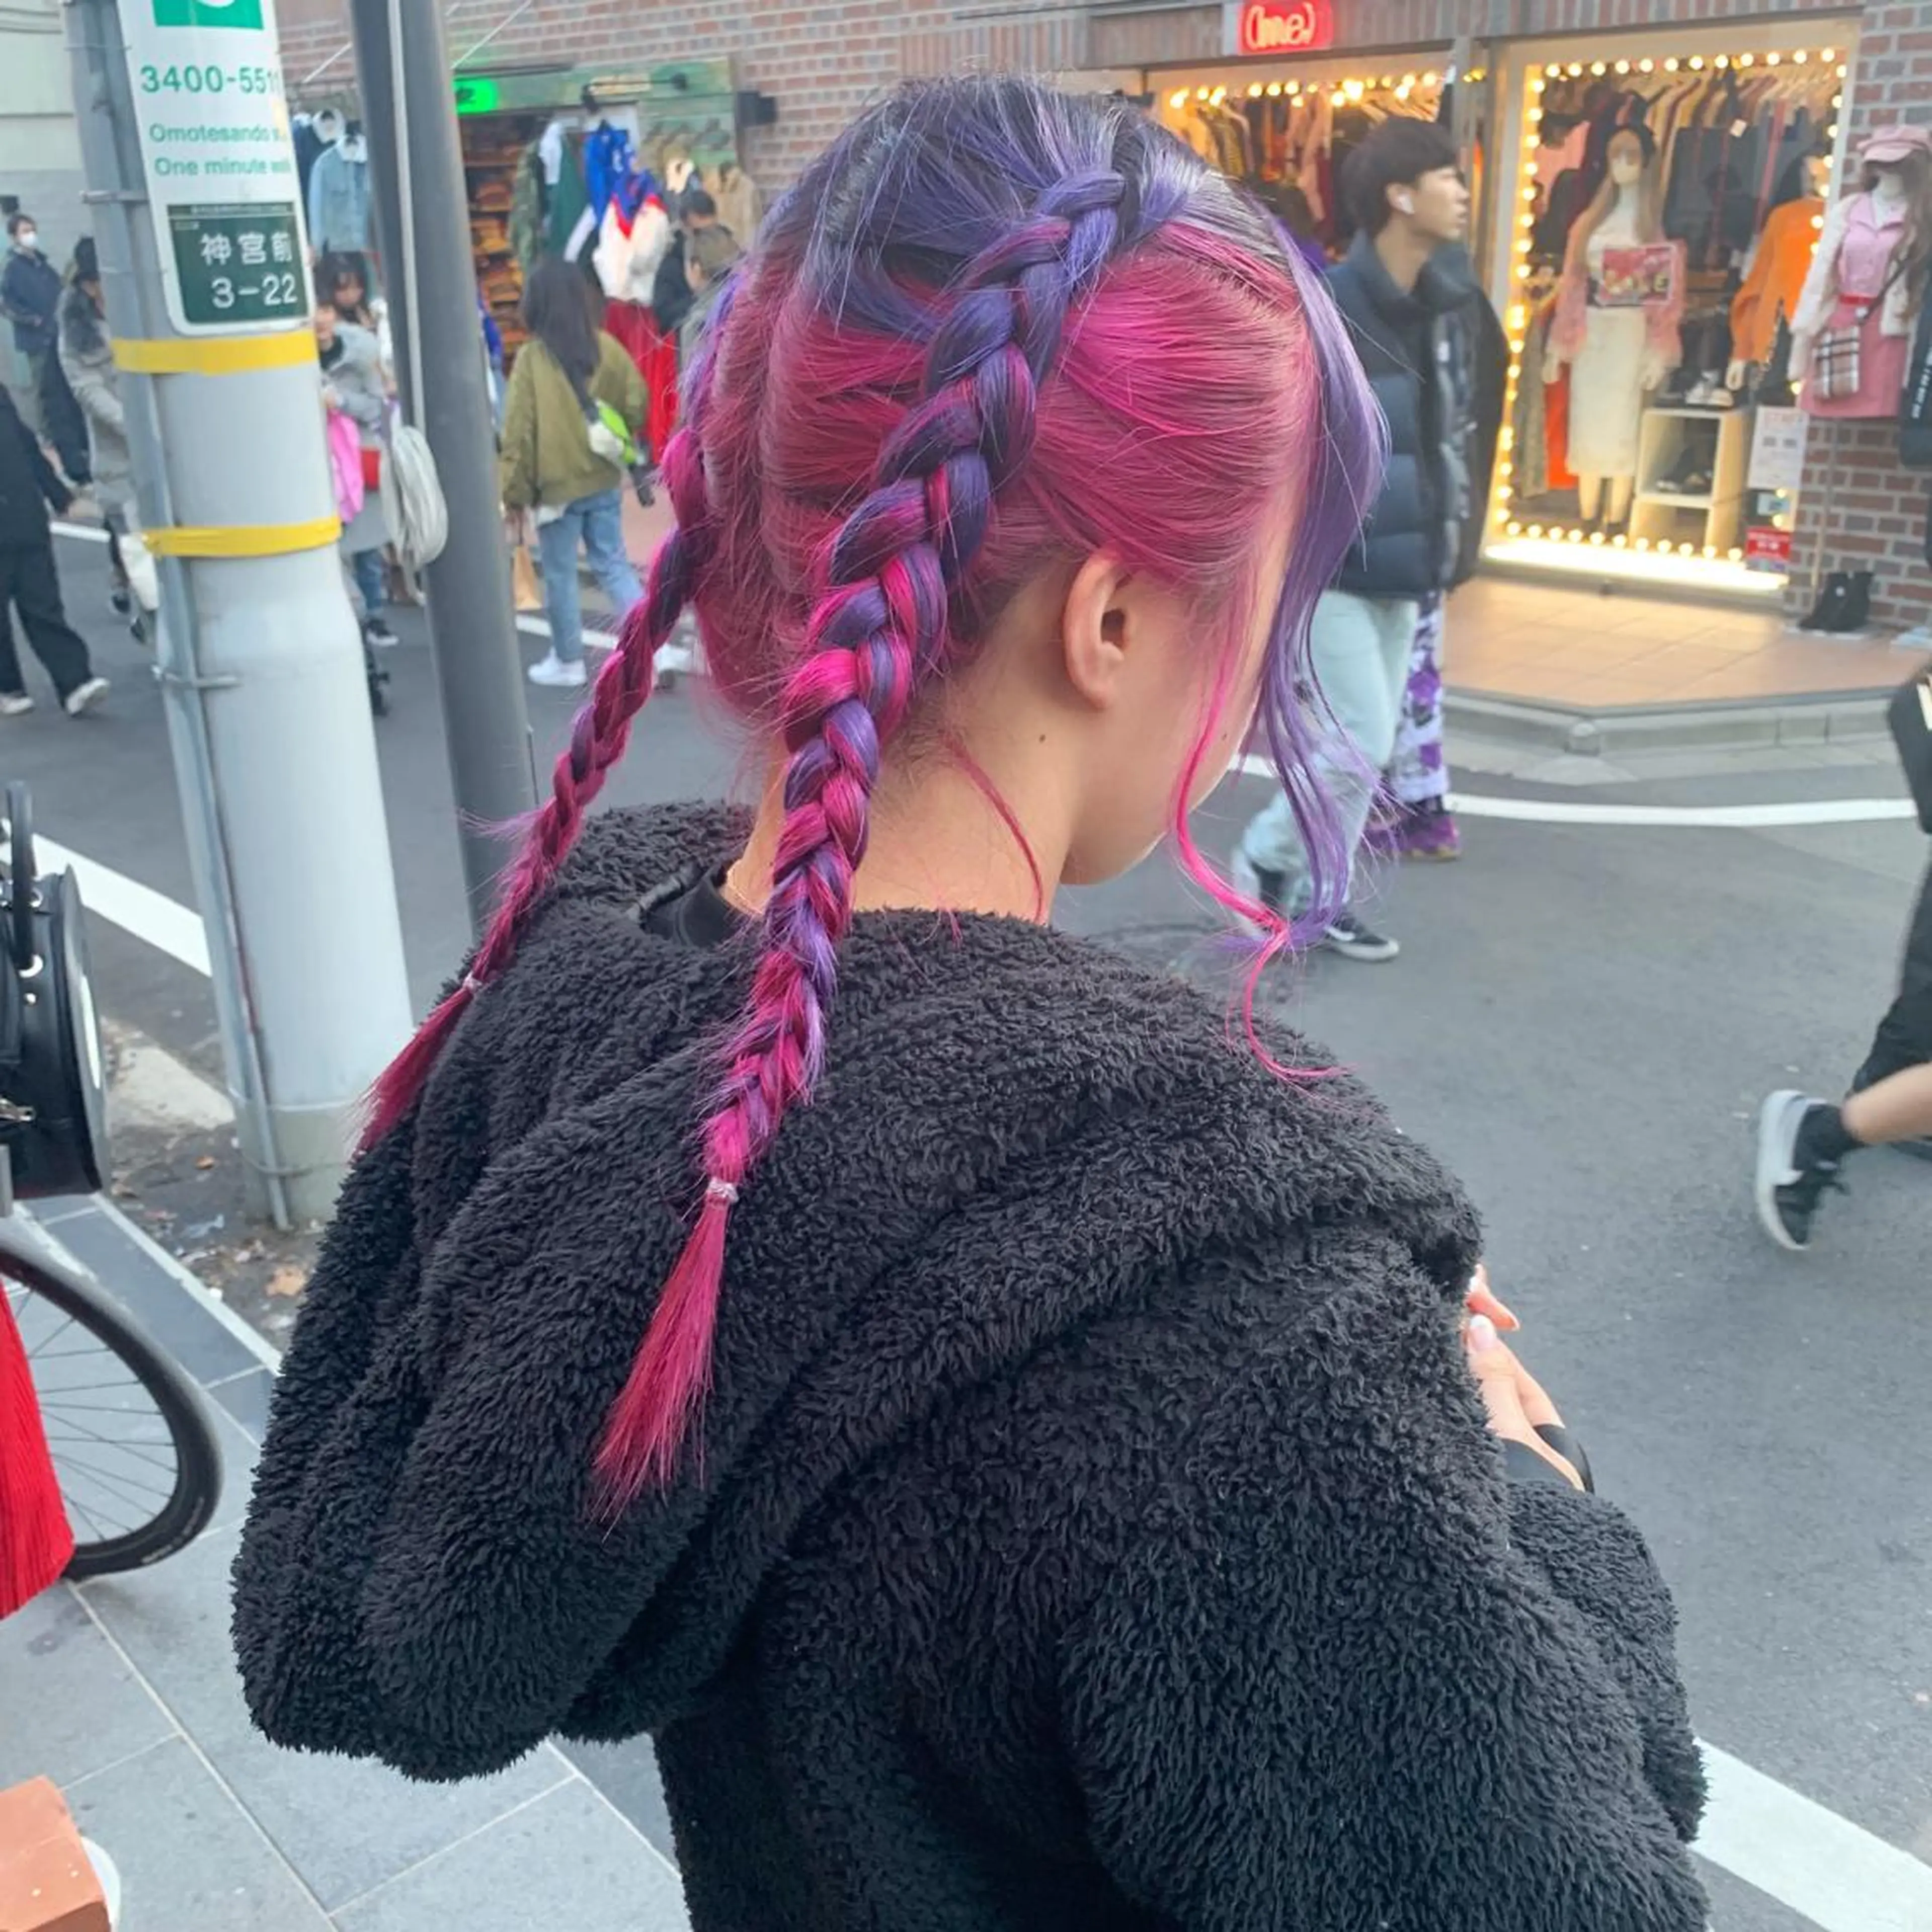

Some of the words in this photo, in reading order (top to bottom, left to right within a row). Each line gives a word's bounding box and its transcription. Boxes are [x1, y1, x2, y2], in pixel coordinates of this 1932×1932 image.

[154, 157, 198, 176] One
[204, 156, 267, 175] minute
[200, 231, 293, 265] 神宮前
